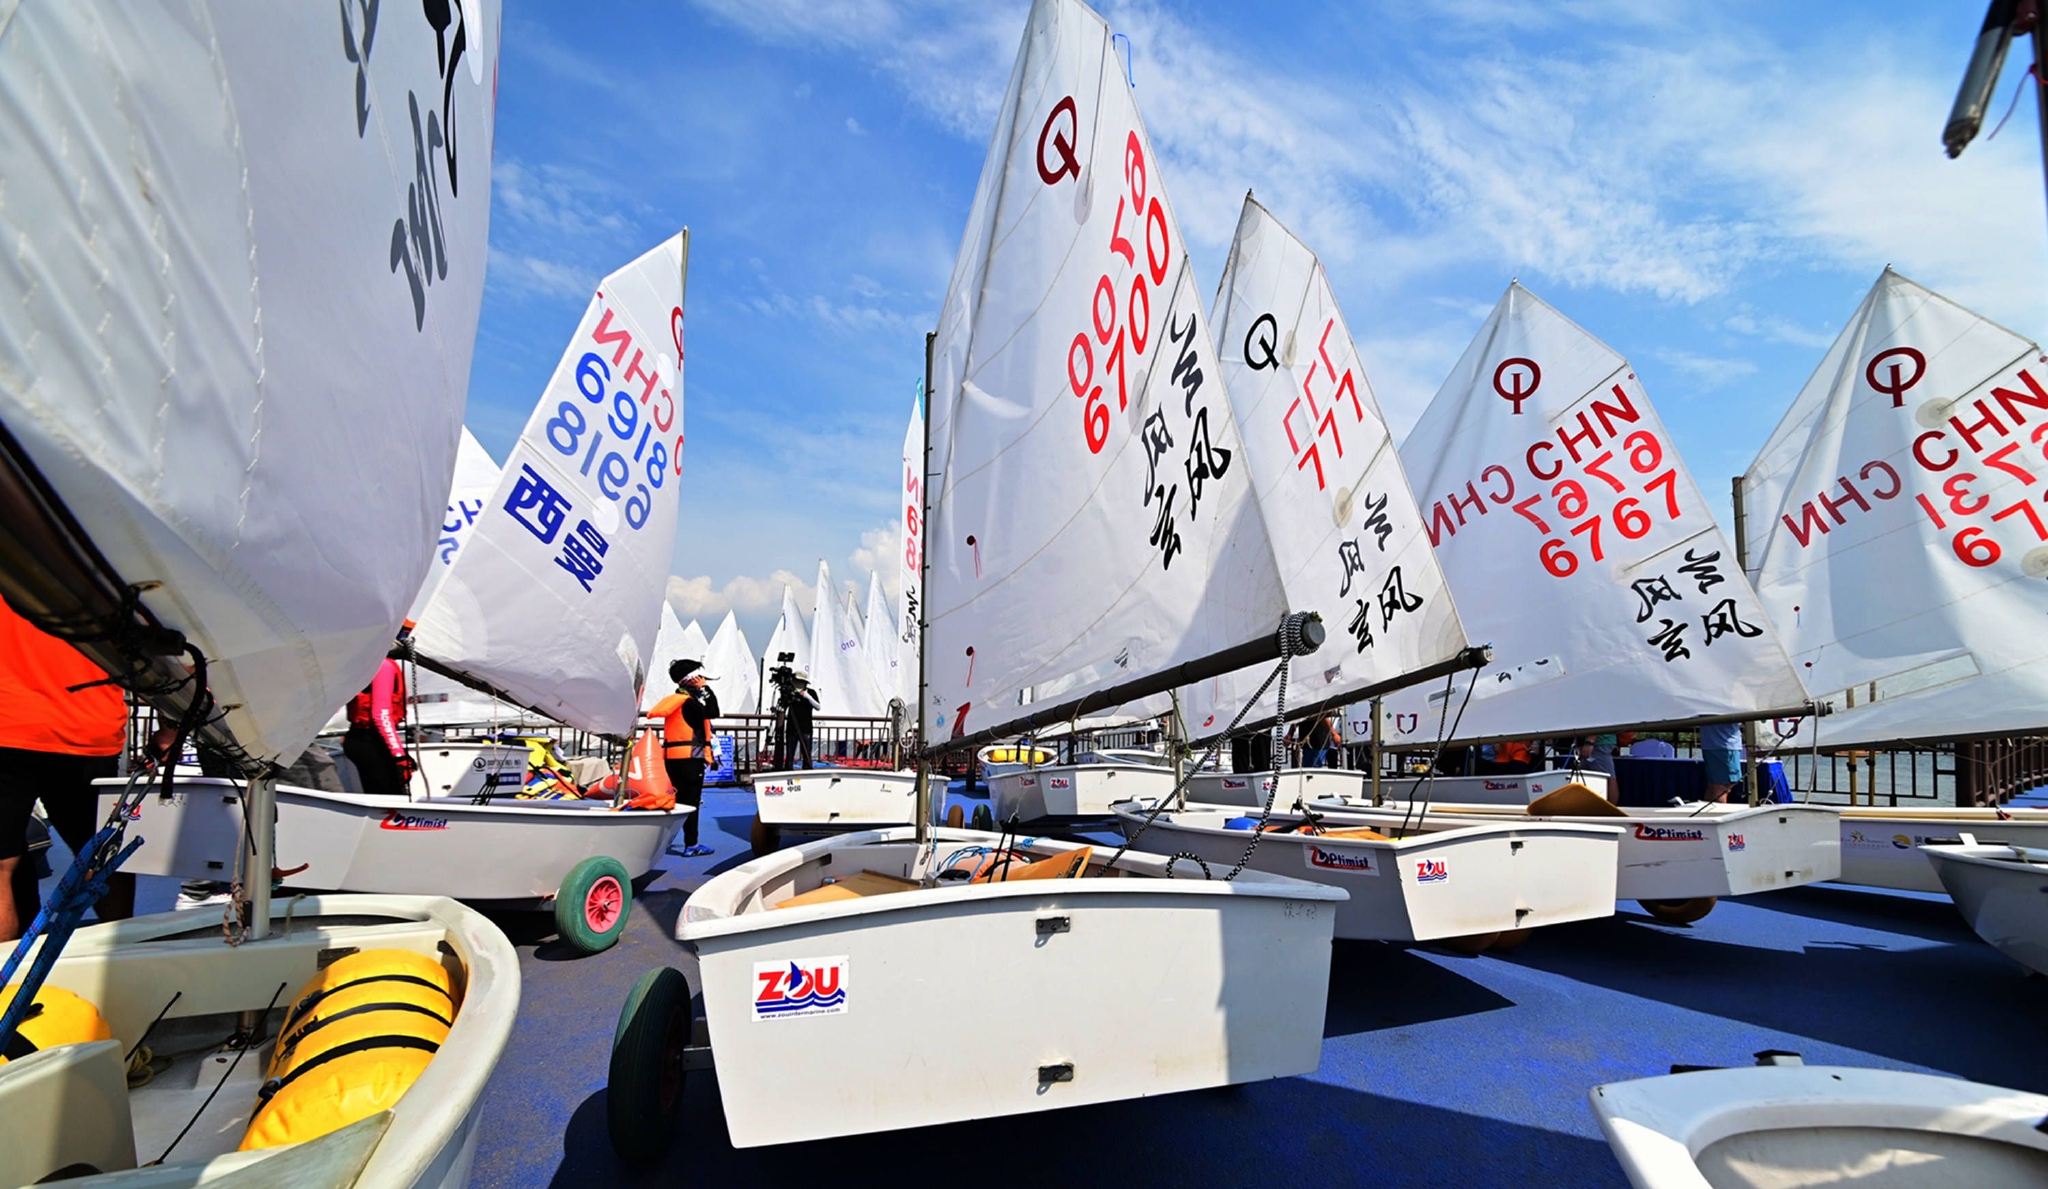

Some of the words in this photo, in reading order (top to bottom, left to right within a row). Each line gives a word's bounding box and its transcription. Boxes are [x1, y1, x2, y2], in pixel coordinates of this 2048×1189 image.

[1084, 197, 1170, 454] 6700
[575, 352, 667, 488] 6918
[1298, 368, 1363, 491] 777
[1526, 384, 1640, 480] CHN
[1912, 369, 2048, 471] CHN
[1540, 468, 1681, 578] 6767
[1417, 861, 1445, 876] ZOU
[757, 966, 839, 1001] ZOU
